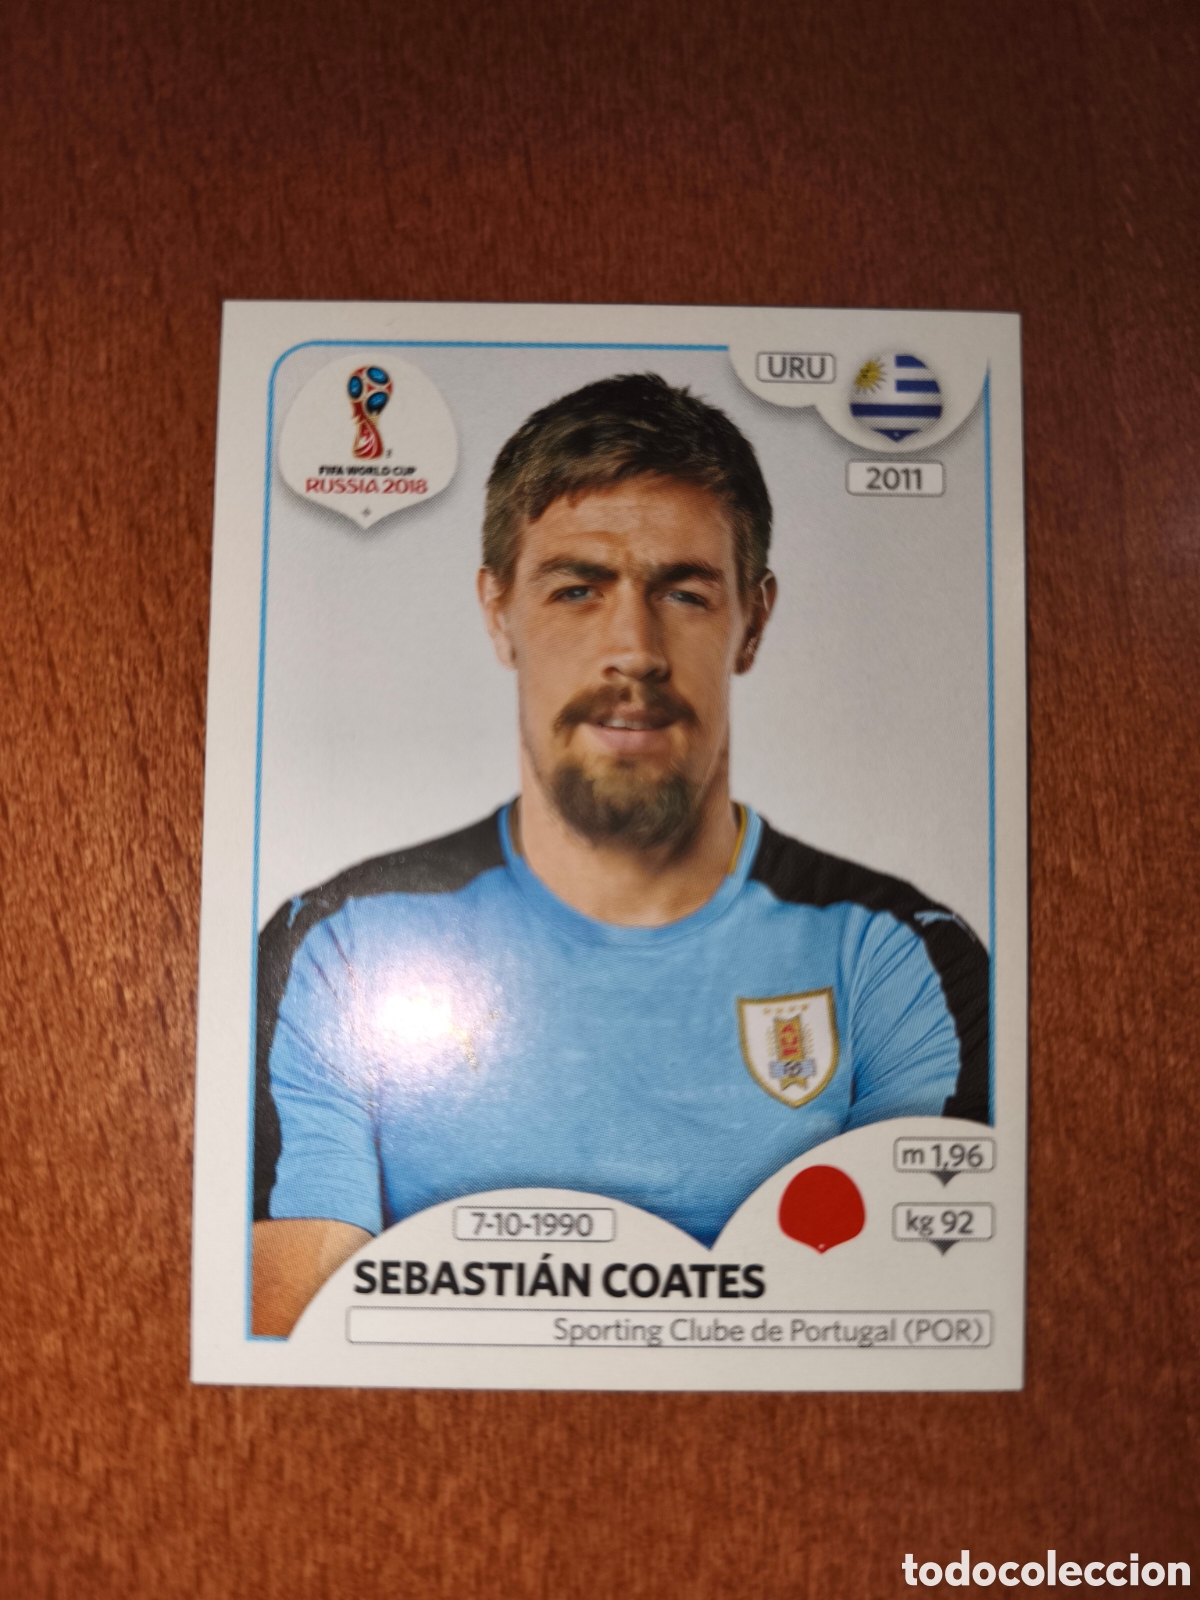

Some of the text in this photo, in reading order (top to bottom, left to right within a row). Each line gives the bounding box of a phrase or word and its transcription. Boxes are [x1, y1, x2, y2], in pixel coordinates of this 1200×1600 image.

[767, 356, 826, 380] URU
[318, 466, 417, 476] FIFA WORLD CUP
[866, 466, 922, 491] 2011
[305, 478, 428, 494] RUSSIA 2018
[901, 1143, 984, 1169] m 1,96
[471, 1212, 594, 1237] 7-10-1990
[906, 1209, 974, 1237] kg 92
[354, 1253, 766, 1299] SEBASTIÁN COATES
[553, 1317, 984, 1348] Sporting Clube de Portugal (POR)
